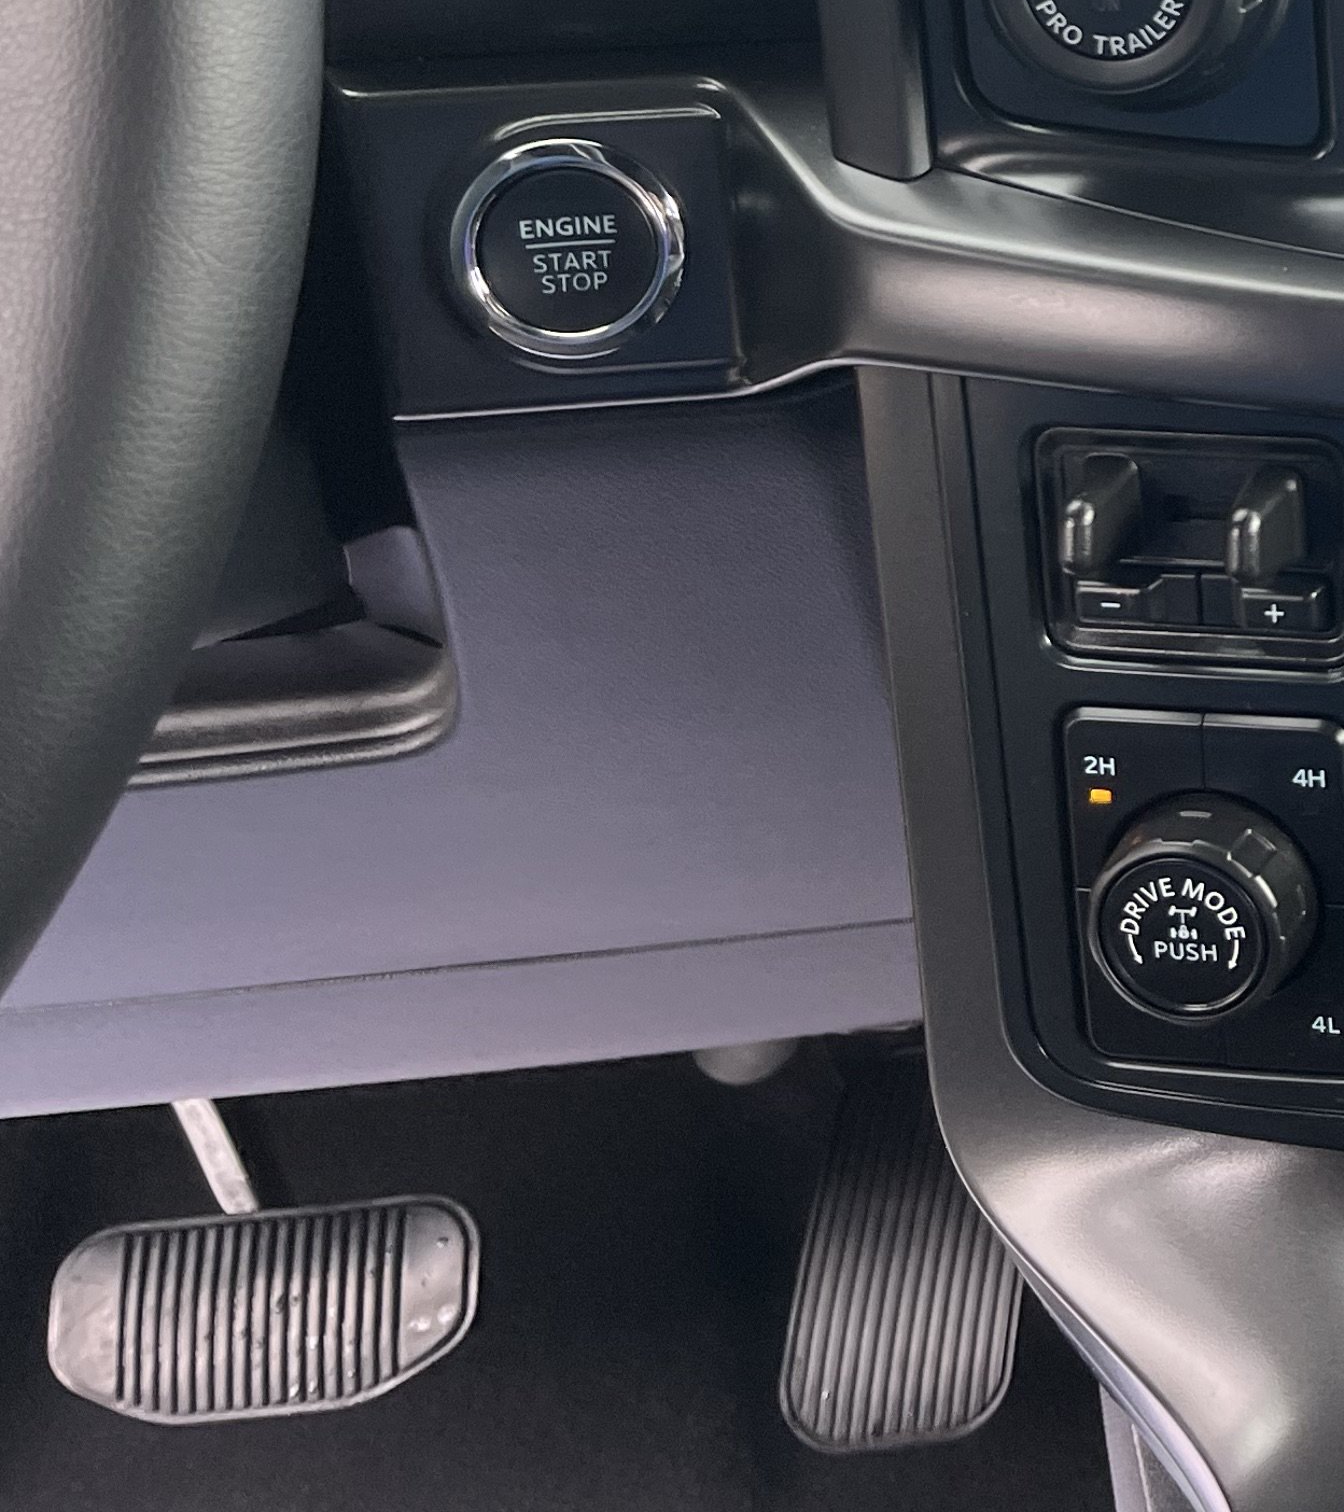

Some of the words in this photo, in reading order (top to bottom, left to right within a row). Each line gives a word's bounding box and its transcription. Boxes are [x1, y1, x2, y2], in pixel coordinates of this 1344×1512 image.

[1036, 0, 1083, 46] PRO
[519, 214, 618, 240] ENGINE
[533, 249, 611, 274] START
[541, 271, 608, 294] STOP
[1083, 755, 1116, 777] 2H
[1292, 769, 1326, 788] 4H
[1120, 876, 1176, 936] DRIVE
[1181, 877, 1246, 941] MODE
[1154, 940, 1218, 962] PUSH
[1312, 1016, 1341, 1035] 4L
